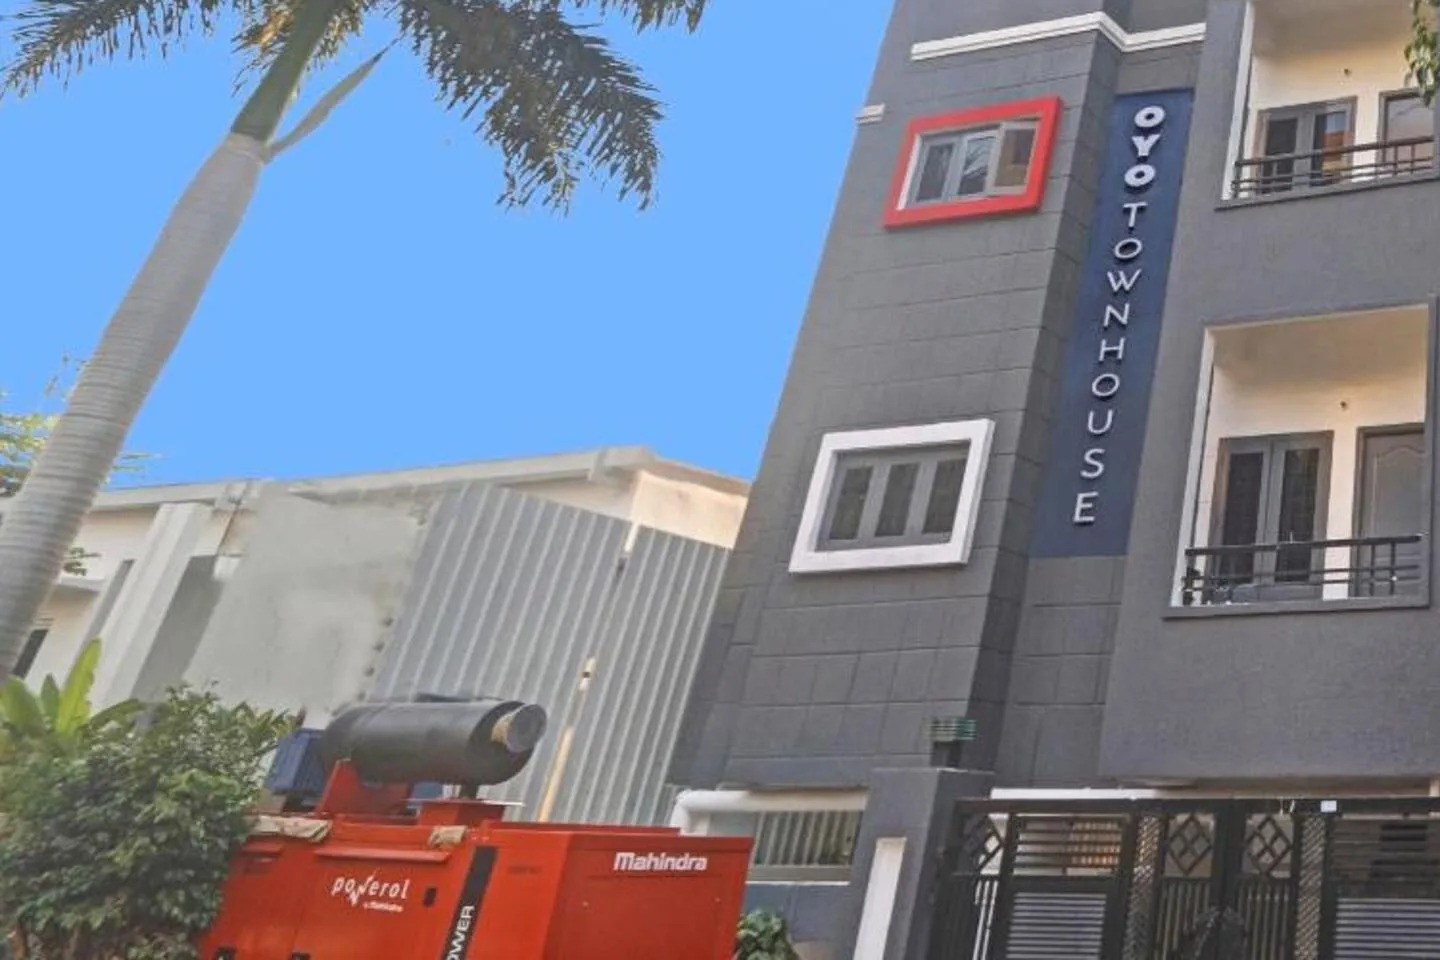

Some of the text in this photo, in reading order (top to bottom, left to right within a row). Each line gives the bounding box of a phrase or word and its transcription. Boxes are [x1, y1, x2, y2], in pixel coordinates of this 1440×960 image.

[1073, 105, 1166, 525] OYO TOWNHOUSE
[613, 851, 708, 872] Mahindra
